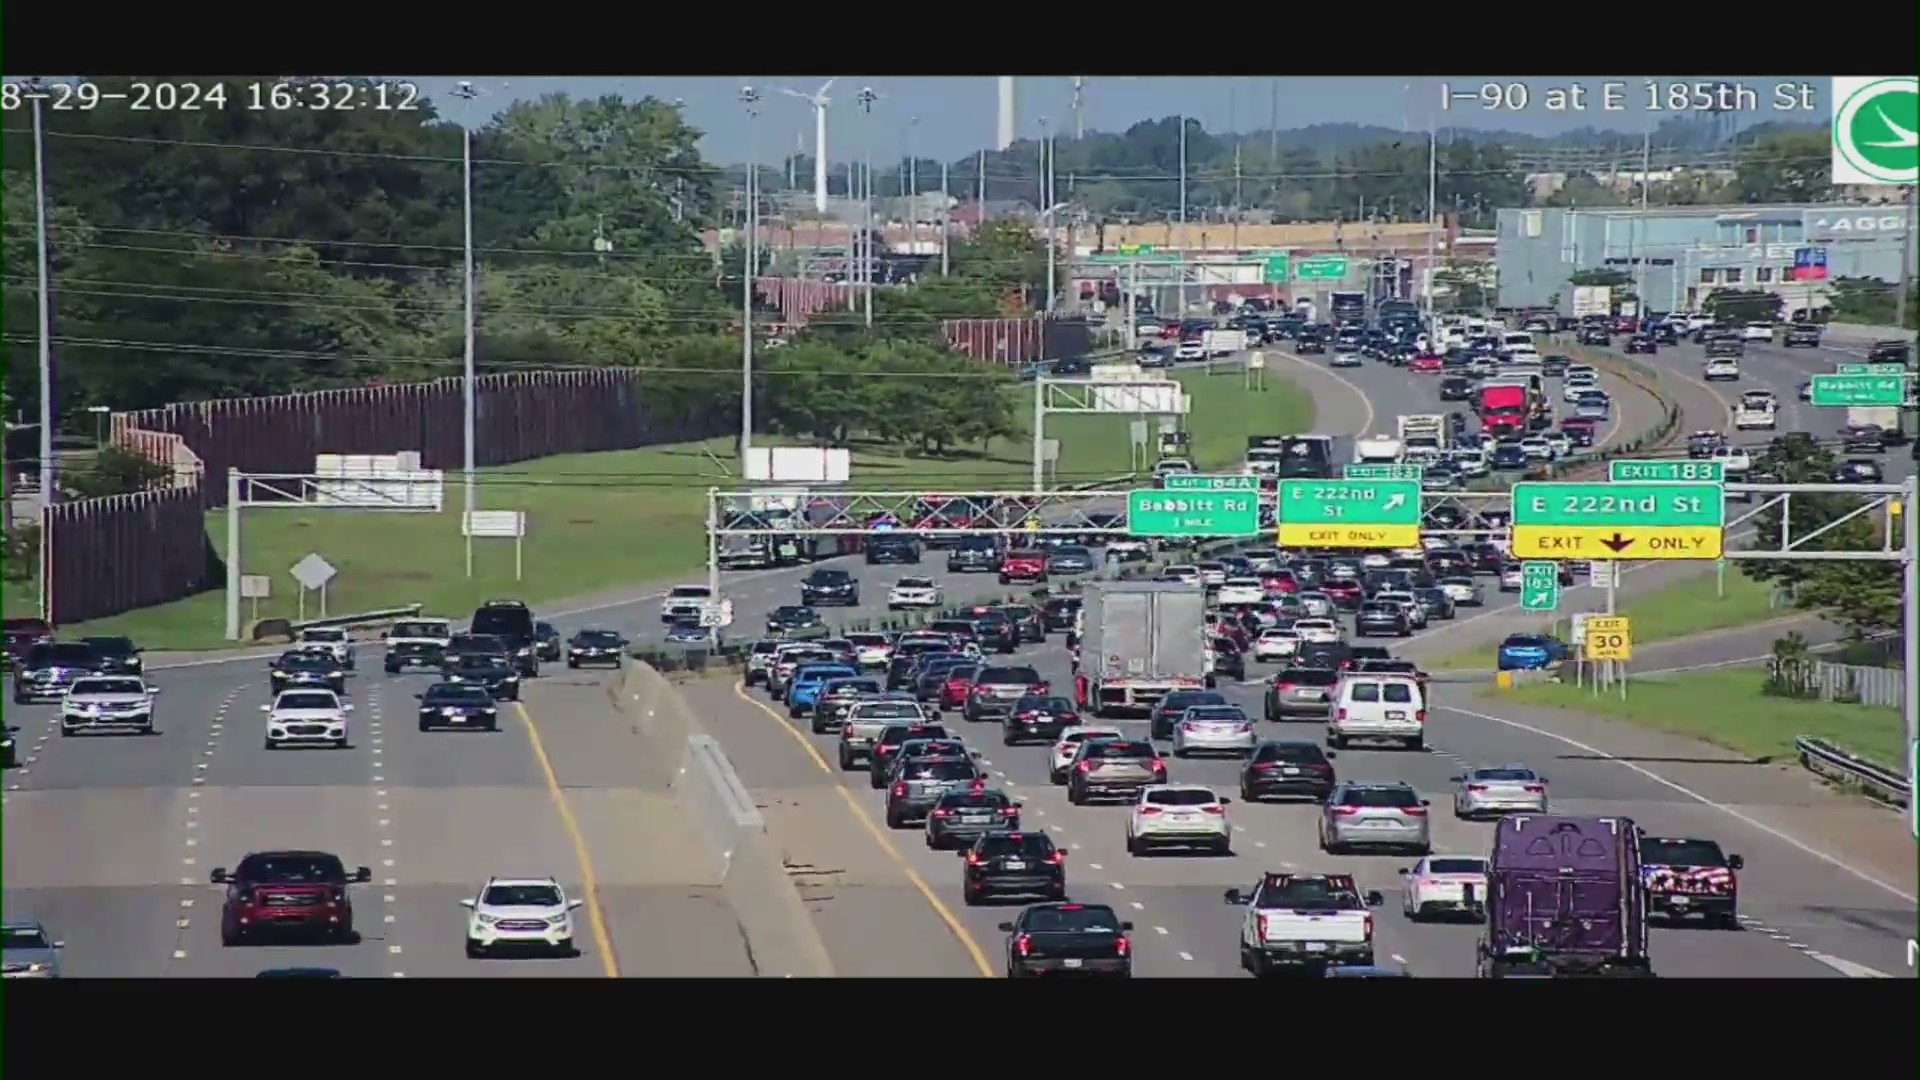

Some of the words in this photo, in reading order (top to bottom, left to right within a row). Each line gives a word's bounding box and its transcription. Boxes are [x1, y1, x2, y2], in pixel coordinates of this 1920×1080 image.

[1830, 216, 1907, 231] AGG
[1621, 466, 1659, 477] EXIT
[1669, 464, 1713, 479] 183
[1291, 488, 1304, 499] E
[1315, 487, 1376, 500] 222nd
[1139, 499, 1214, 512] Babbitt
[1225, 499, 1247, 512] Rd
[1325, 504, 1344, 517] St
[1532, 497, 1546, 513] E
[1563, 495, 1657, 513] 222nd
[1673, 496, 1701, 513] St
[1310, 531, 1339, 541] EXIT
[1349, 531, 1387, 541] ONLY
[1538, 536, 1584, 549] EXIT
[1649, 536, 1707, 549] ONLY
[1525, 566, 1553, 575] EXIT
[1526, 578, 1553, 589] 183
[1595, 635, 1623, 648] 30
